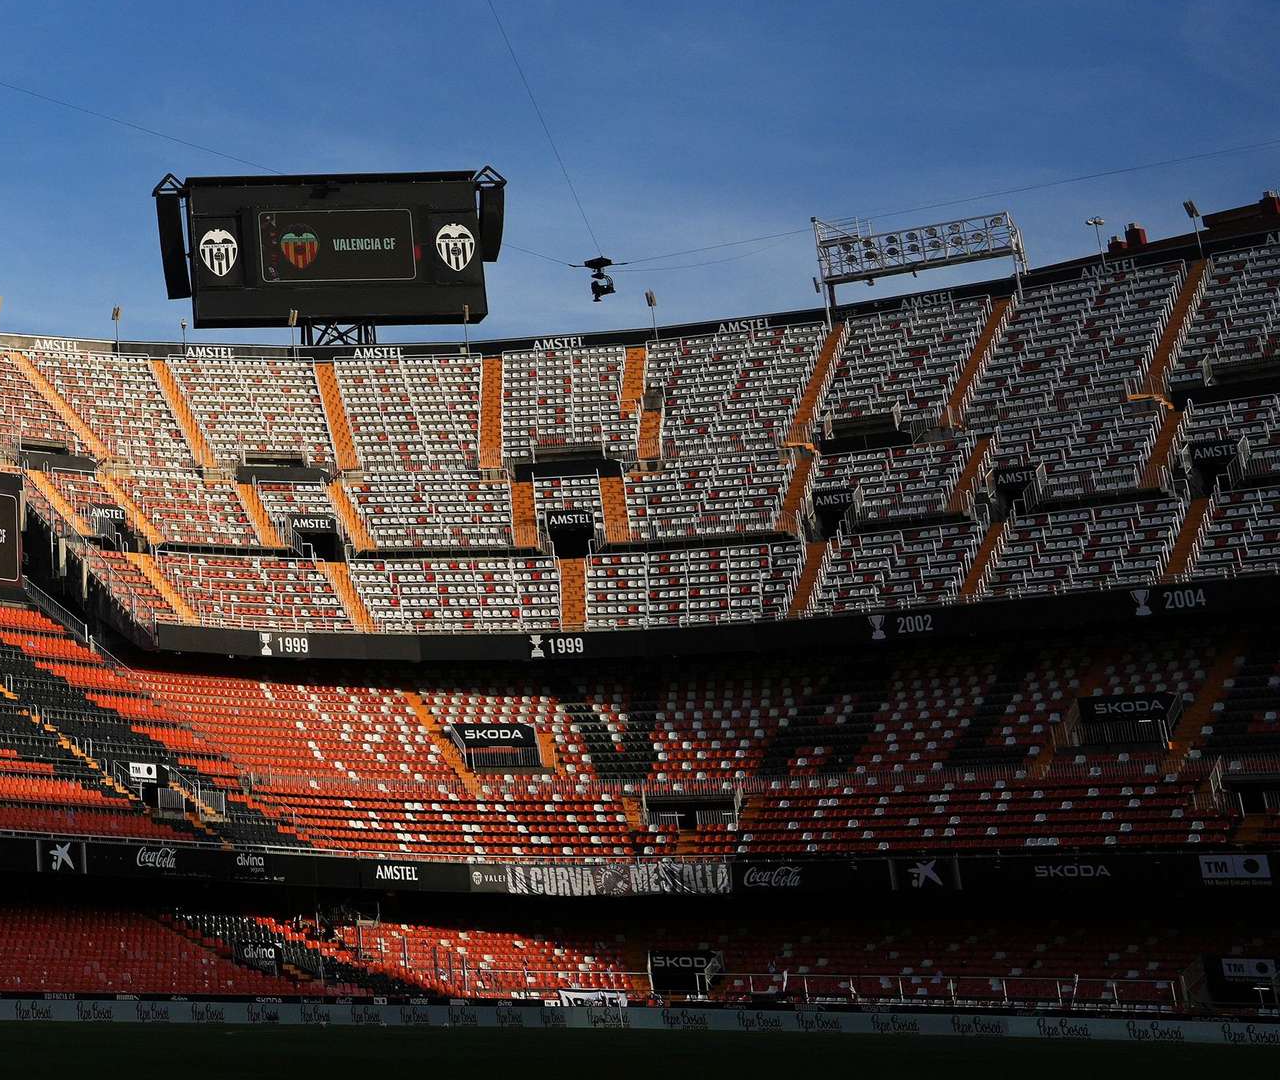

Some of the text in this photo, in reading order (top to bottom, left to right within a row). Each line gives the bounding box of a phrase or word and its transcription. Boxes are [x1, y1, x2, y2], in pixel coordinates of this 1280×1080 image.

[333, 237, 396, 252] VALENCIA CF
[33, 338, 79, 353] AMSTEL
[533, 337, 584, 352] AMSTEL
[185, 346, 234, 360] AMSTEL
[353, 346, 403, 359] AMSTEL
[90, 507, 125, 520] AMSTEL
[549, 513, 591, 525] AMSTEL
[292, 518, 331, 530] AMSTEL
[1162, 589, 1207, 611] 2004
[896, 615, 935, 635] 2002
[278, 637, 308, 654] 1999
[548, 637, 584, 654] 1999
[237, 852, 265, 866] divina
[376, 865, 418, 882] AMSTEL
[1204, 861, 1228, 873] TM
[506, 865, 530, 895] LA
[530, 865, 596, 896] CURVA
[244, 943, 275, 958] divina
